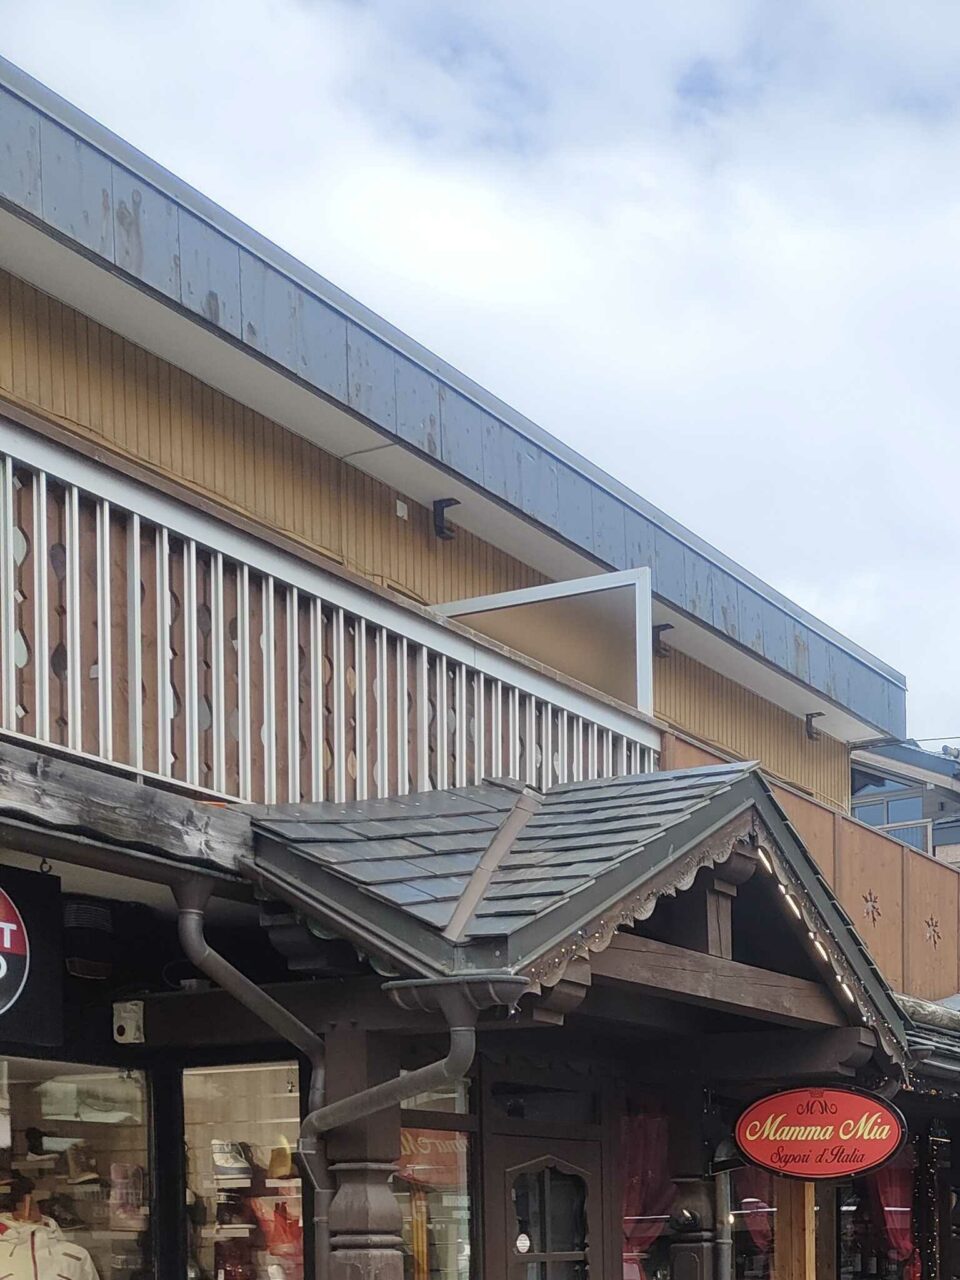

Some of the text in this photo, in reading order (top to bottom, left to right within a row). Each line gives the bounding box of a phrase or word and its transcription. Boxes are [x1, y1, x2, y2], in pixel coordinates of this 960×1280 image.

[745, 1111, 892, 1141] Mamma Mia
[770, 1145, 866, 1168] Sapori d'Italia
